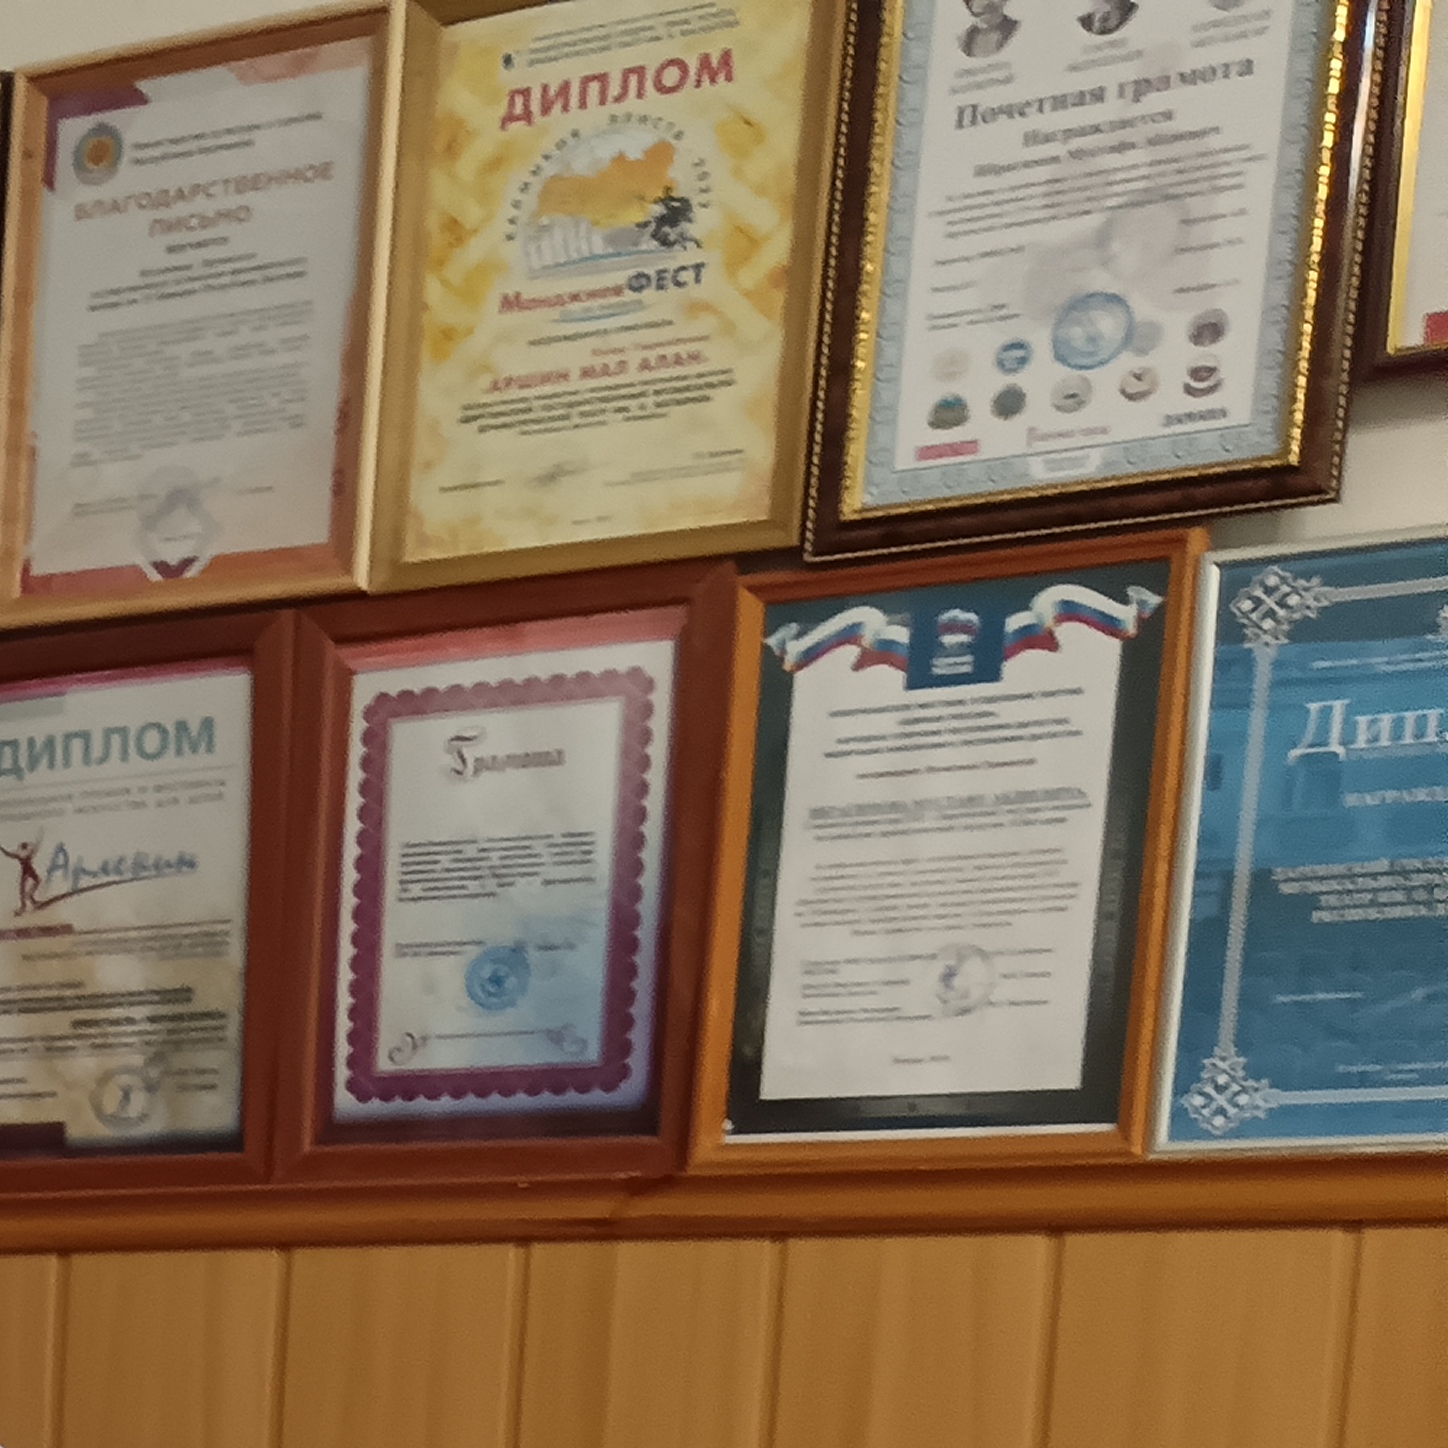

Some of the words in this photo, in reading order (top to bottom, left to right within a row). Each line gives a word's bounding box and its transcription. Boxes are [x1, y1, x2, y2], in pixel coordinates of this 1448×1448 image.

[499, 47, 734, 131] ДИПЛОМ
[954, 85, 1107, 130] Почетная
[1117, 58, 1254, 103] грамота
[73, 160, 334, 221] БЛАГОДАРСТВЕННОЕ
[148, 205, 253, 238] ПИСЬМО
[1287, 698, 1448, 765] Дип
